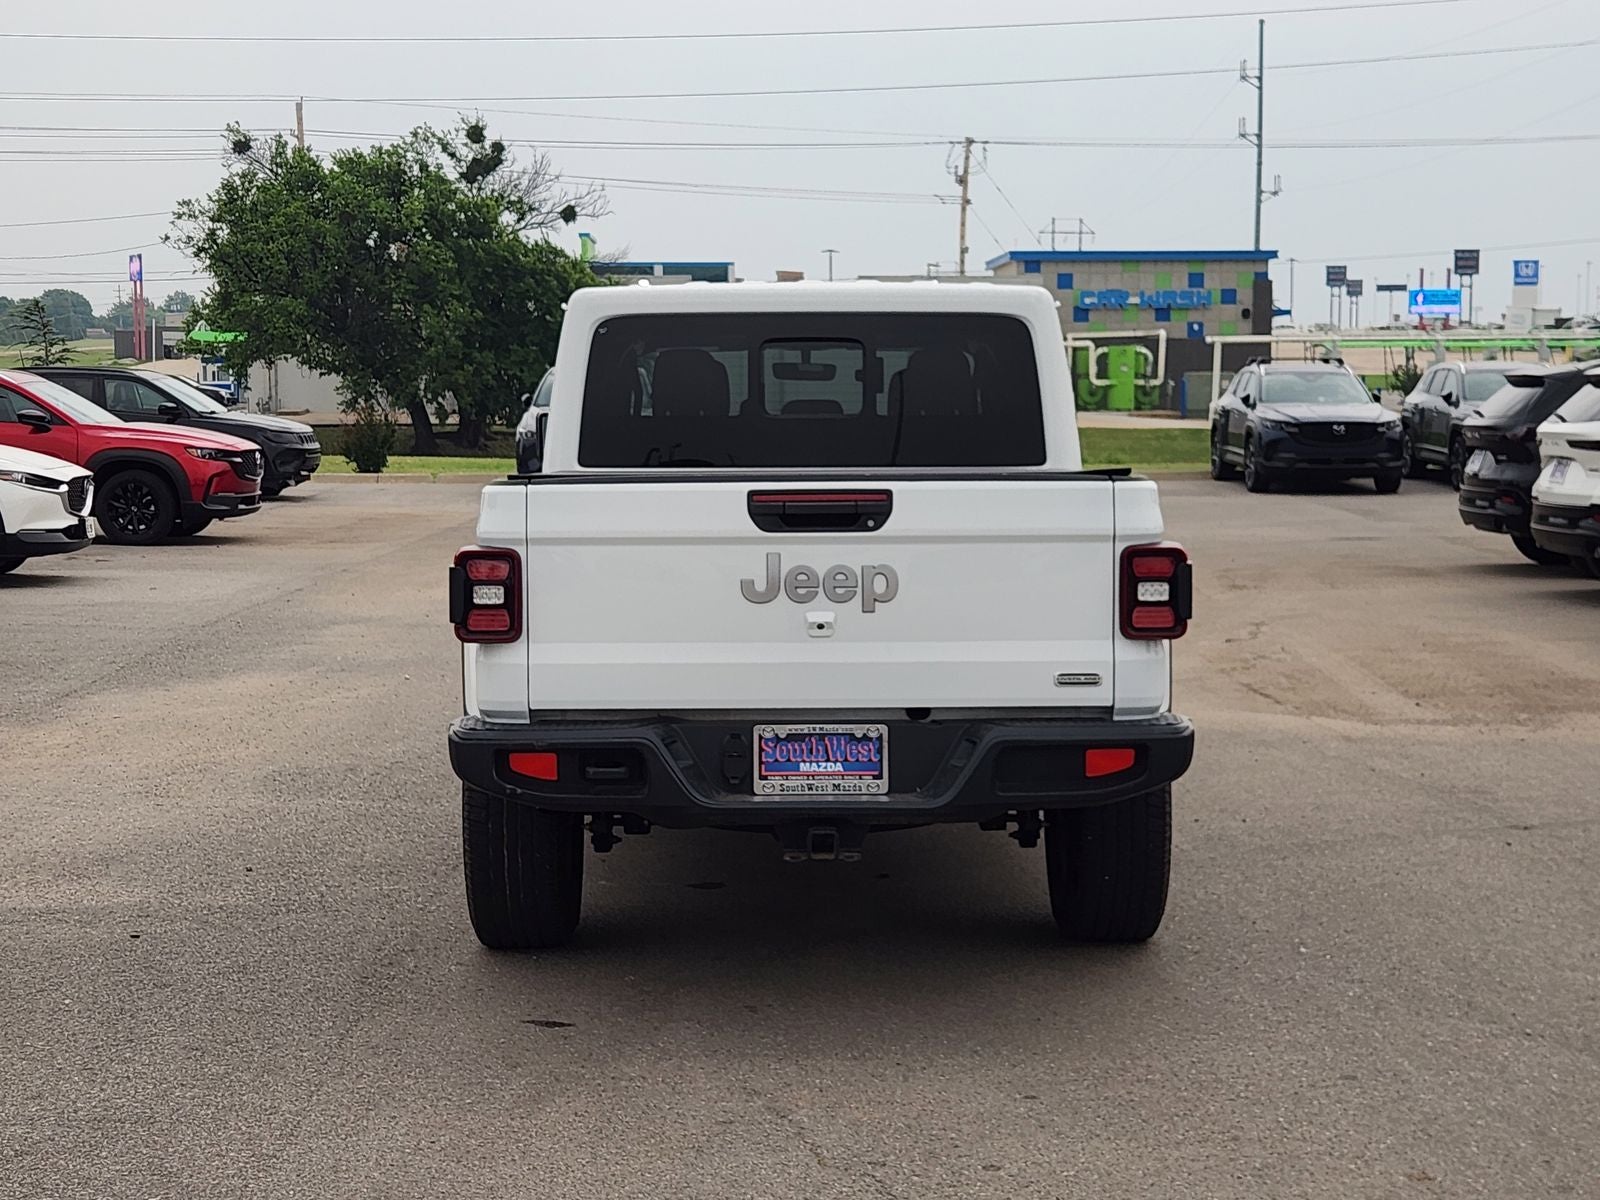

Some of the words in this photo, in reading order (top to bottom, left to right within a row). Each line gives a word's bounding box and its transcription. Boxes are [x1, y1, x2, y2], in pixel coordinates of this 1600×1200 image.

[1079, 289, 1130, 309] CAR
[1138, 289, 1213, 309] WASH
[740, 552, 899, 613] Jeep
[761, 736, 880, 762] SouthWest
[799, 762, 844, 772] MAZDA
[779, 782, 829, 792] SouthWest
[832, 782, 863, 792] Mazda
